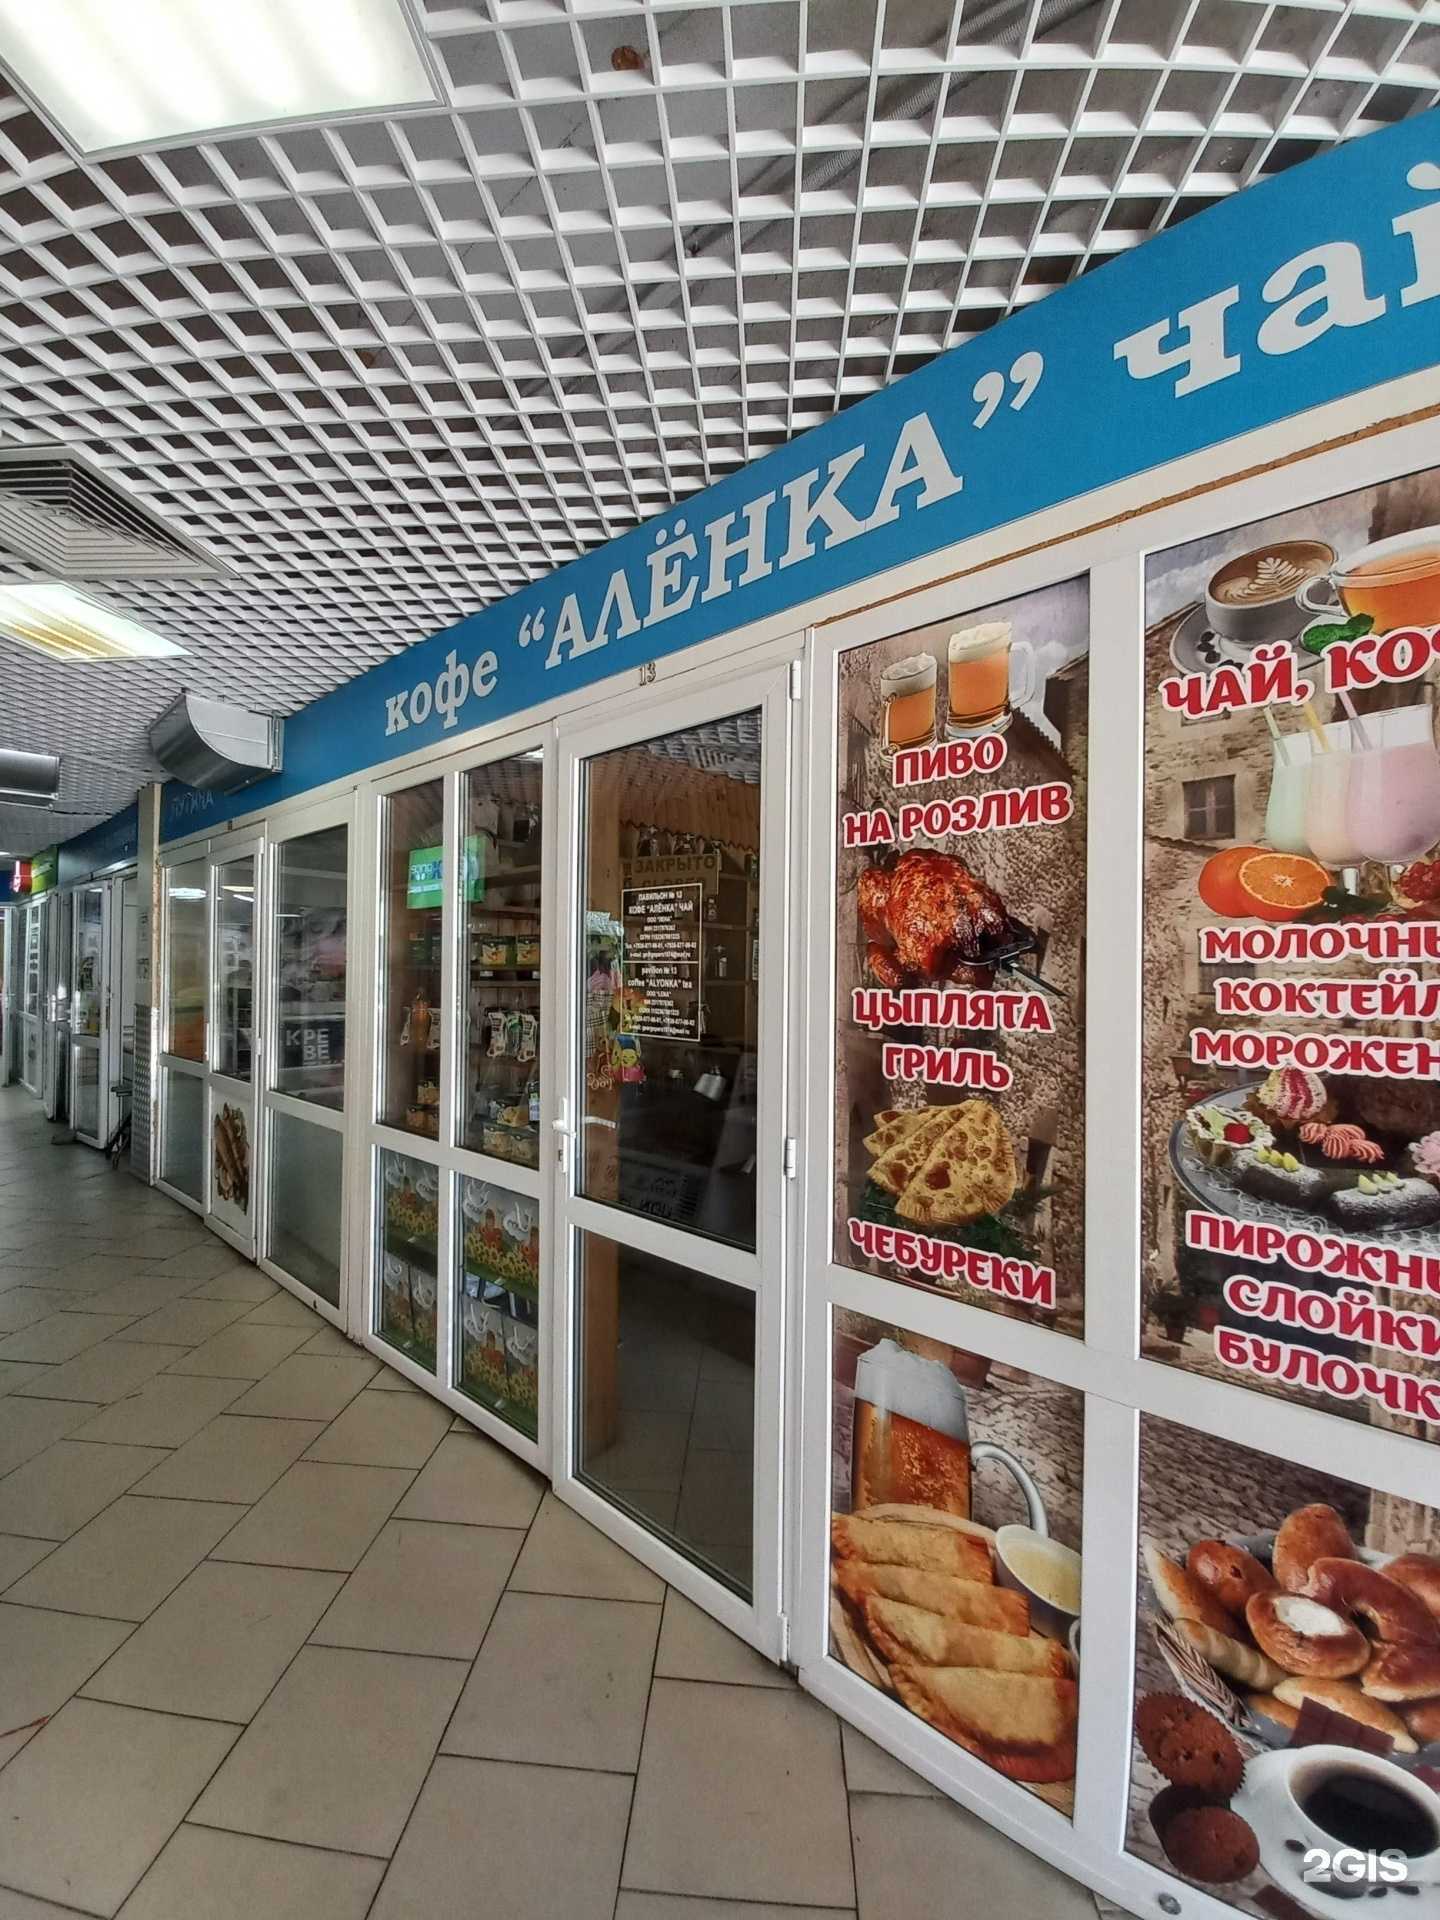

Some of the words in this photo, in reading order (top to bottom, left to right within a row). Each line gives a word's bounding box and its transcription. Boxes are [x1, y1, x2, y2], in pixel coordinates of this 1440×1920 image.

[384, 646, 498, 737] кофе
[639, 662, 657, 686] 13
[1160, 641, 1314, 718] ЧАЙ,
[1325, 627, 1440, 692] КО
[894, 734, 1006, 787] ПИВО
[844, 810, 894, 847] НА
[902, 783, 1072, 840] РОЗЛИВ
[634, 855, 716, 874] ЗАКРЫТО
[629, 905, 646, 915] КОФЕ
[679, 900, 694, 912] ЧАЙ
[638, 892, 669, 901] ПАВИЛЬОН
[628, 979, 645, 987] coffee
[682, 980, 693, 989] tea
[854, 990, 1053, 1032] ЦЫПЛЯТА
[883, 1044, 1012, 1091] ГРИЛЬ
[849, 1218, 1055, 1308] ЧЕБУРЕКИ
